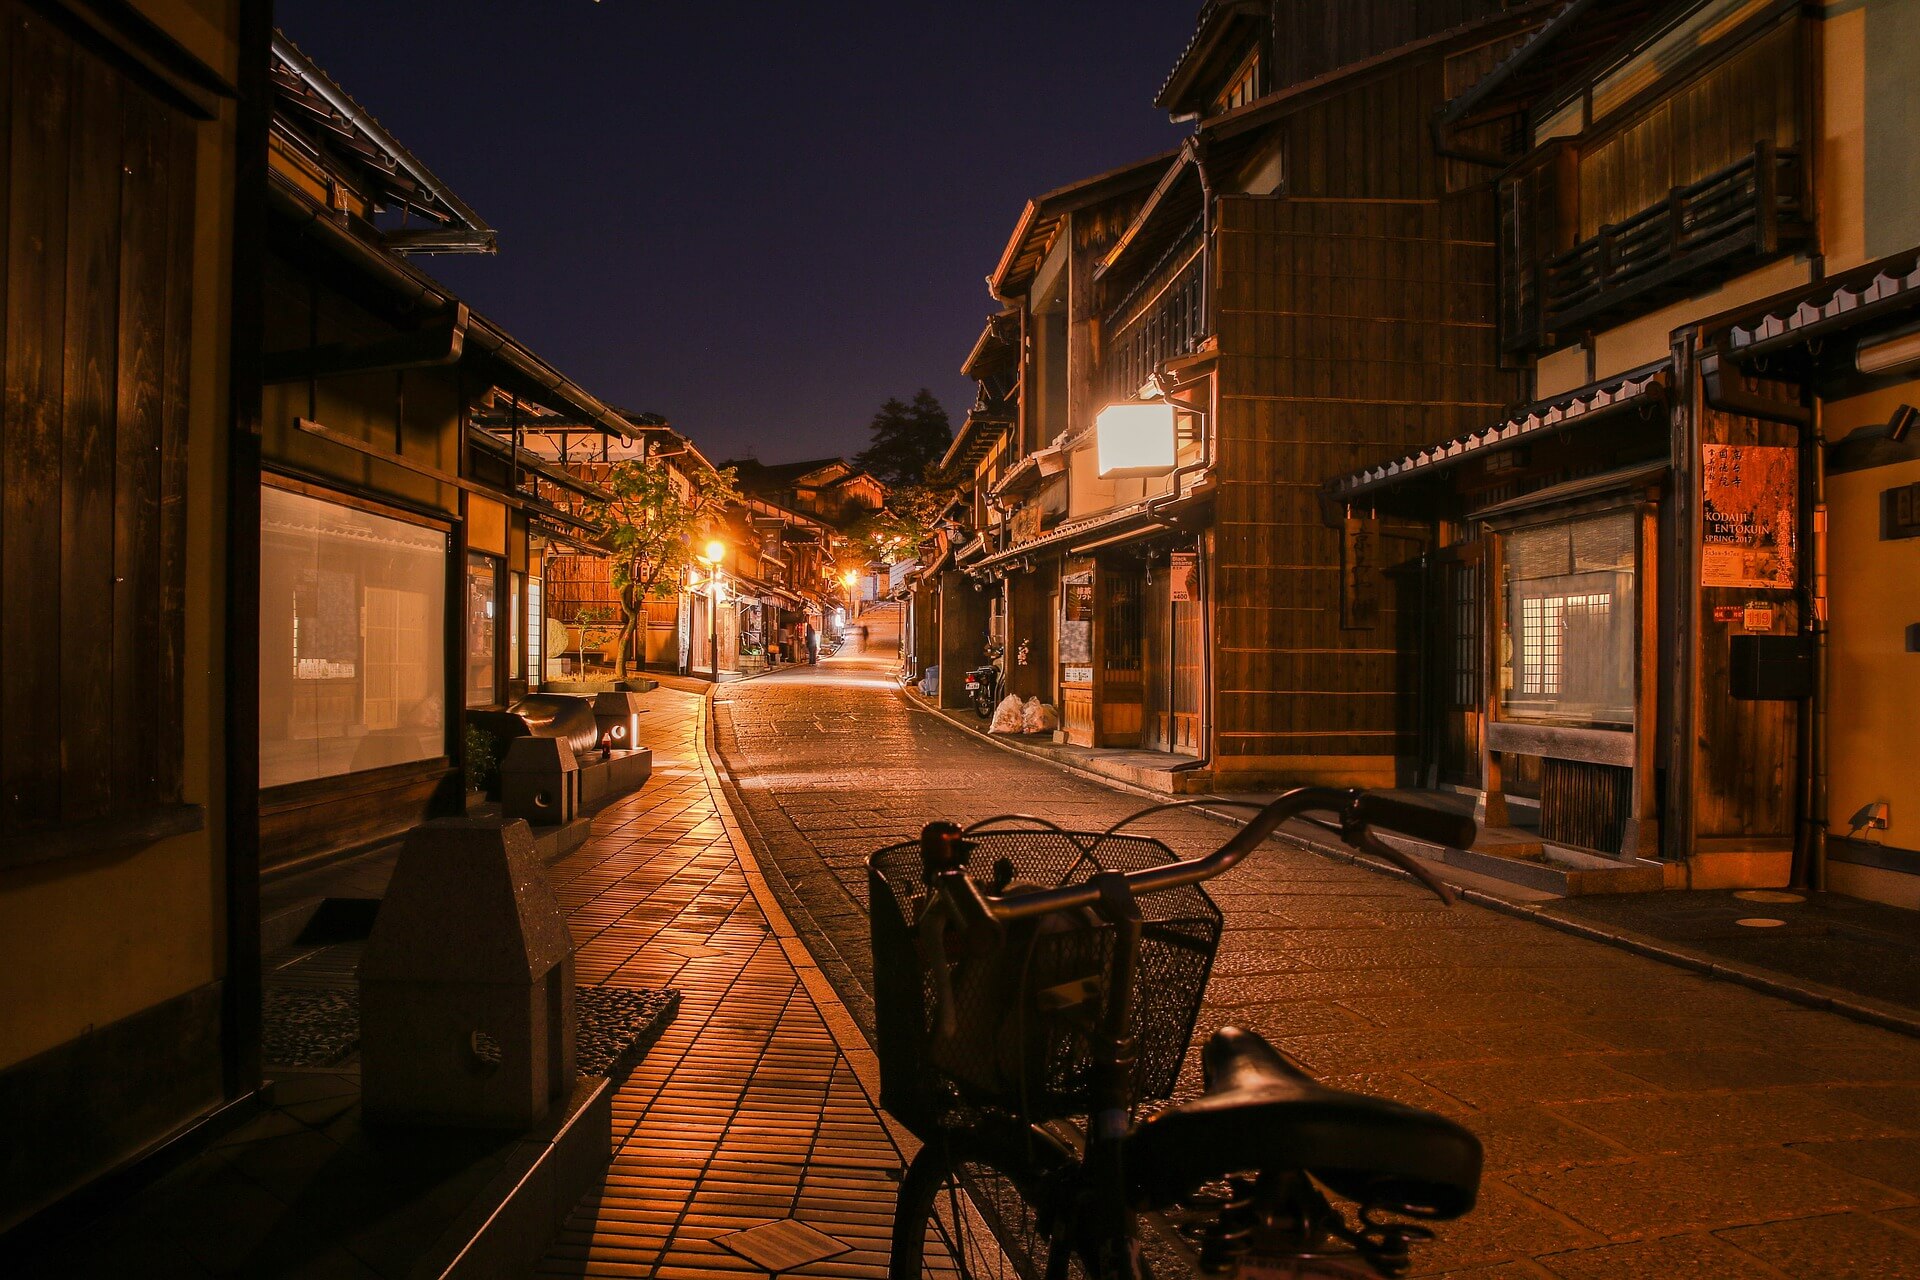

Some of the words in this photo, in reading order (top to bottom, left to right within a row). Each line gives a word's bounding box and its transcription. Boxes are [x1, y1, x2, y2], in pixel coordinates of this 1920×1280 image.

[1705, 511, 1747, 524] KODAIJI
[1715, 523, 1769, 534] ENTOKUIN
[1705, 534, 1734, 543] SPRING
[1735, 535, 1752, 543] 2017
[1747, 612, 1770, 625] 119
